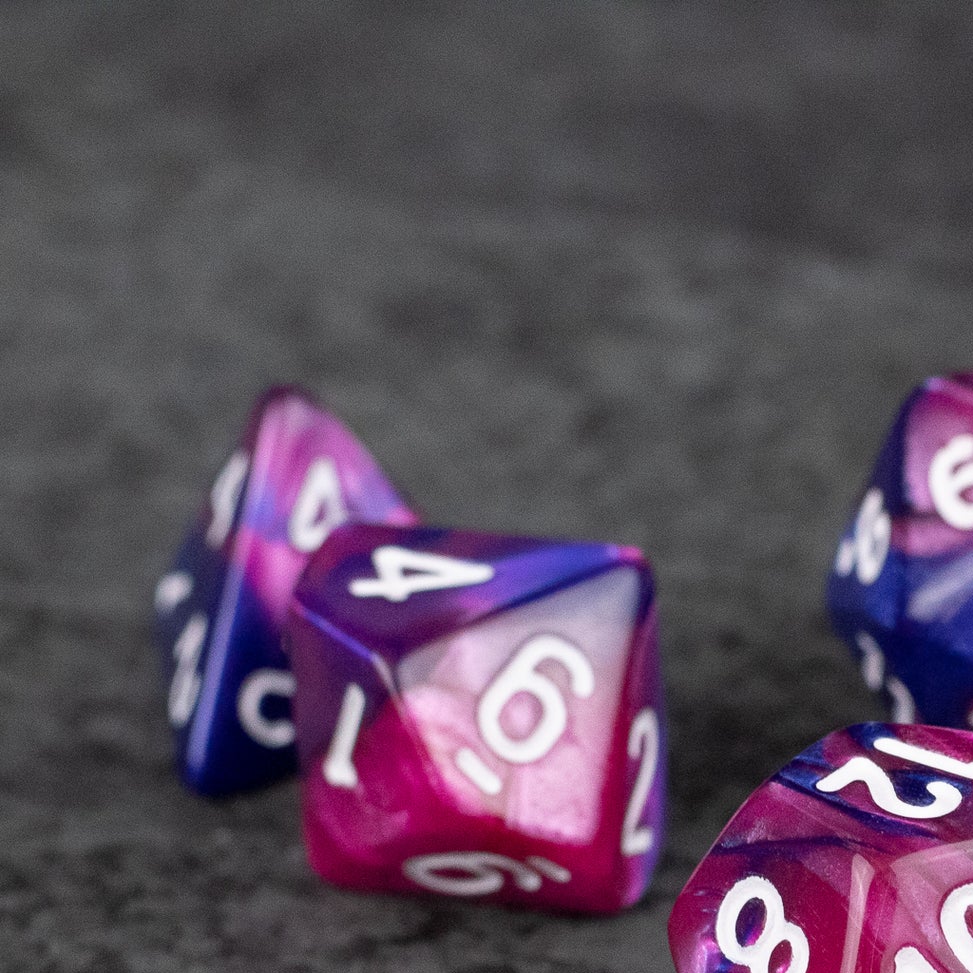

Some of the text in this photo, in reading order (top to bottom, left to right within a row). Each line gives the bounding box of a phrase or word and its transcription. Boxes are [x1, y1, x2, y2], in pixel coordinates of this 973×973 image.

[349, 546, 494, 601] 4
[324, 684, 365, 788] 1
[622, 710, 660, 856] 2
